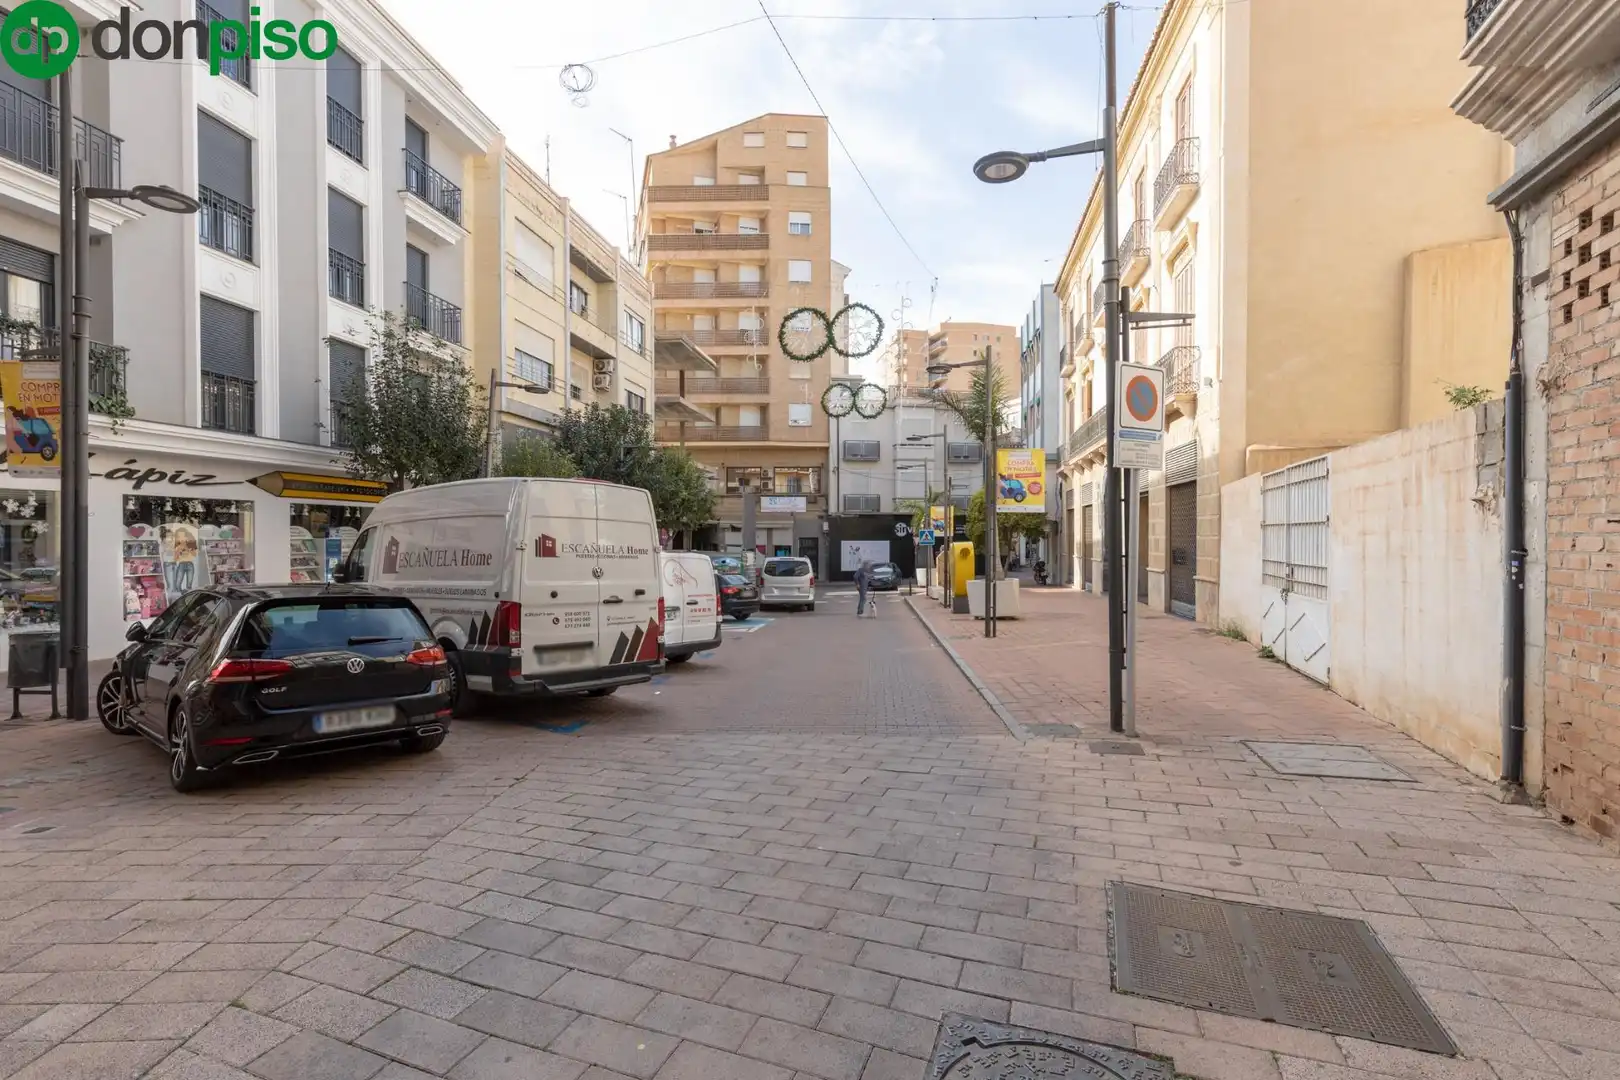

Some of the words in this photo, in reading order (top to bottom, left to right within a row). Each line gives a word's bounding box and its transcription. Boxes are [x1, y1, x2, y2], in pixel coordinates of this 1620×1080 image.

[20, 381, 60, 392] COMPR
[34, 393, 60, 403] MOT
[89, 453, 245, 490] ápiz
[561, 542, 625, 554] ESCAÑUELA
[626, 546, 649, 555] Home
[398, 547, 458, 569] ESCAÑUELA
[460, 548, 492, 567] Home
[261, 686, 288, 694] GOLF
